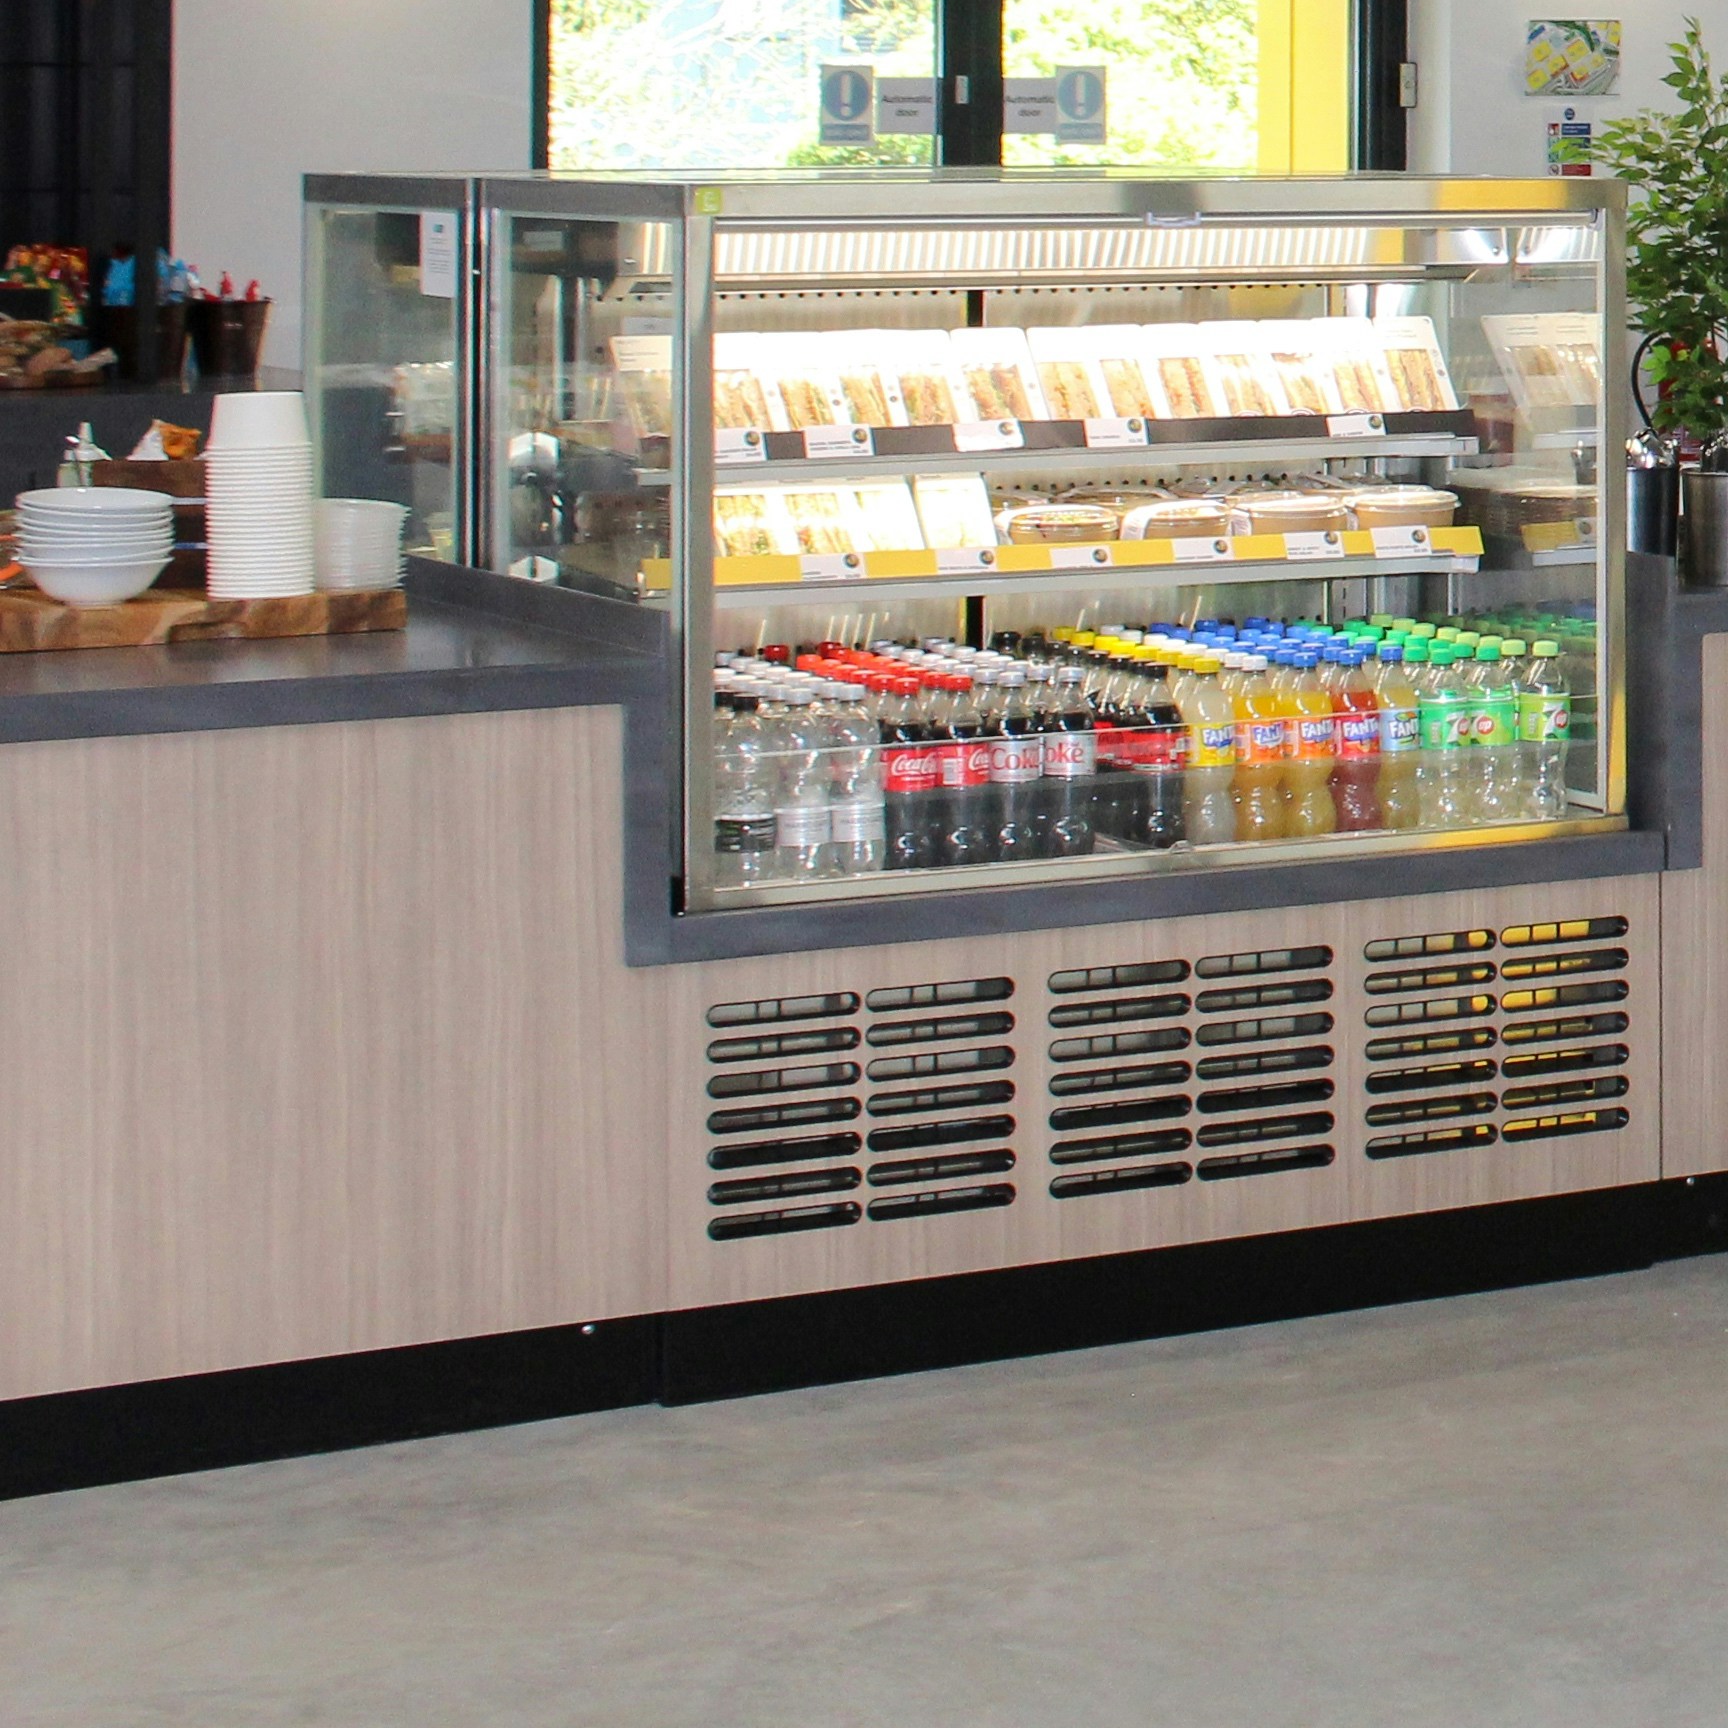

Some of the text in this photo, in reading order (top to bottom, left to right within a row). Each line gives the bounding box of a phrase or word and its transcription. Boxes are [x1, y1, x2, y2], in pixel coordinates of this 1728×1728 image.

[882, 94, 933, 105] Automatic
[1005, 94, 1056, 105] Automatic
[895, 108, 919, 118] door
[1018, 108, 1042, 118] door
